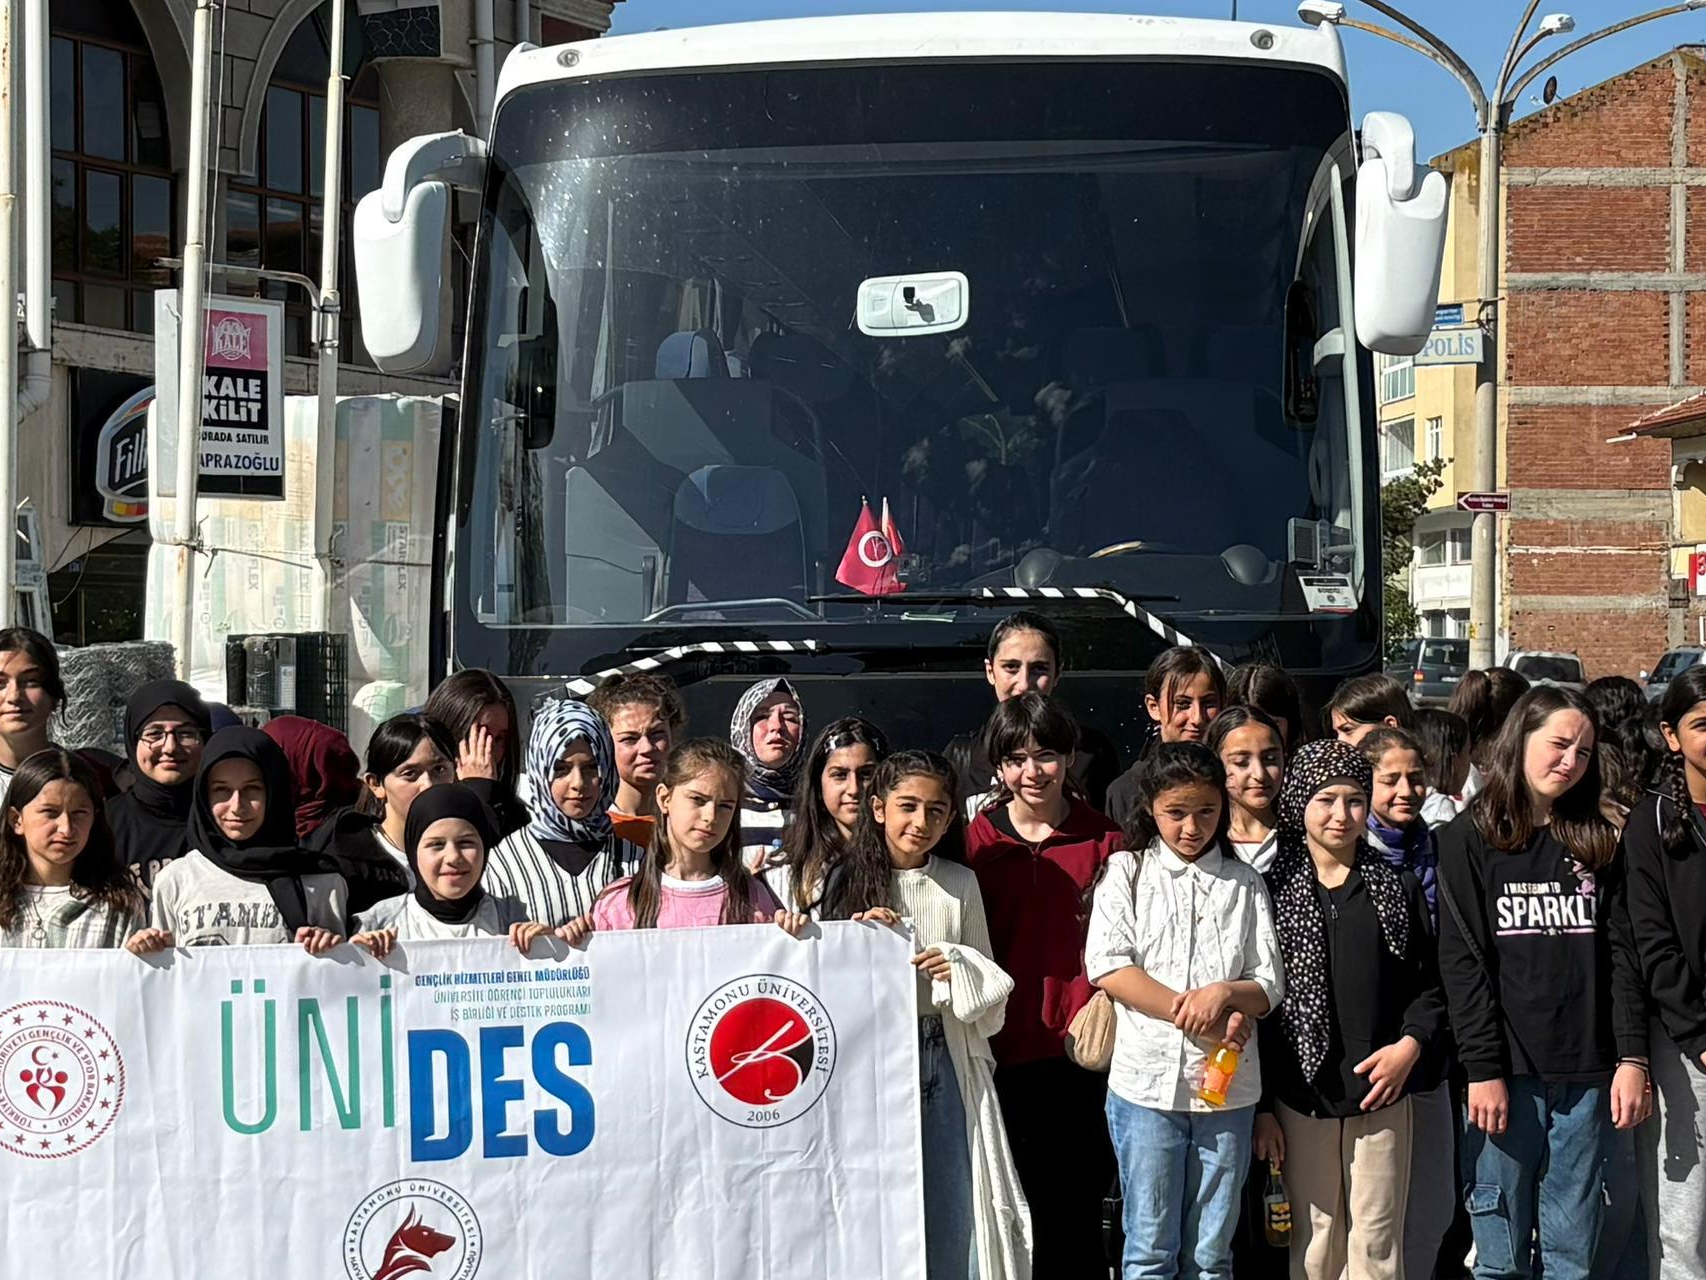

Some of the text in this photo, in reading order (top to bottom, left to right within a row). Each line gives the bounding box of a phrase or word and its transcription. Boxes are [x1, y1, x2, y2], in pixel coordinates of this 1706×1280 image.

[1423, 333, 1475, 357] POLİS
[204, 375, 261, 399] KALE
[200, 431, 269, 444] URADA SATILIR
[199, 452, 279, 471] APRAZOĞLU
[415, 966, 590, 987] GENÇLİK HİZMETLERİ GENEL MÜDÜRLÜĞÜ
[434, 988, 484, 1004] ÜNİVERSİTE
[496, 1006, 507, 1019] VE
[510, 1004, 543, 1019] DESTEK
[544, 1003, 591, 1017] PROGRAMI
[29, 1029, 71, 1045] GENÇLİK
[693, 978, 829, 1080] KASTAMONU ÜNİVERSİTESİ
[72, 1041, 84, 1054] VE
[81, 1053, 97, 1081] SPOR
[57, 1082, 97, 1128] BAKANLIĞI
[747, 1109, 780, 1121] 2006
[349, 1182, 477, 1243] KASTAMONU ÜNİVERSİTESİ
